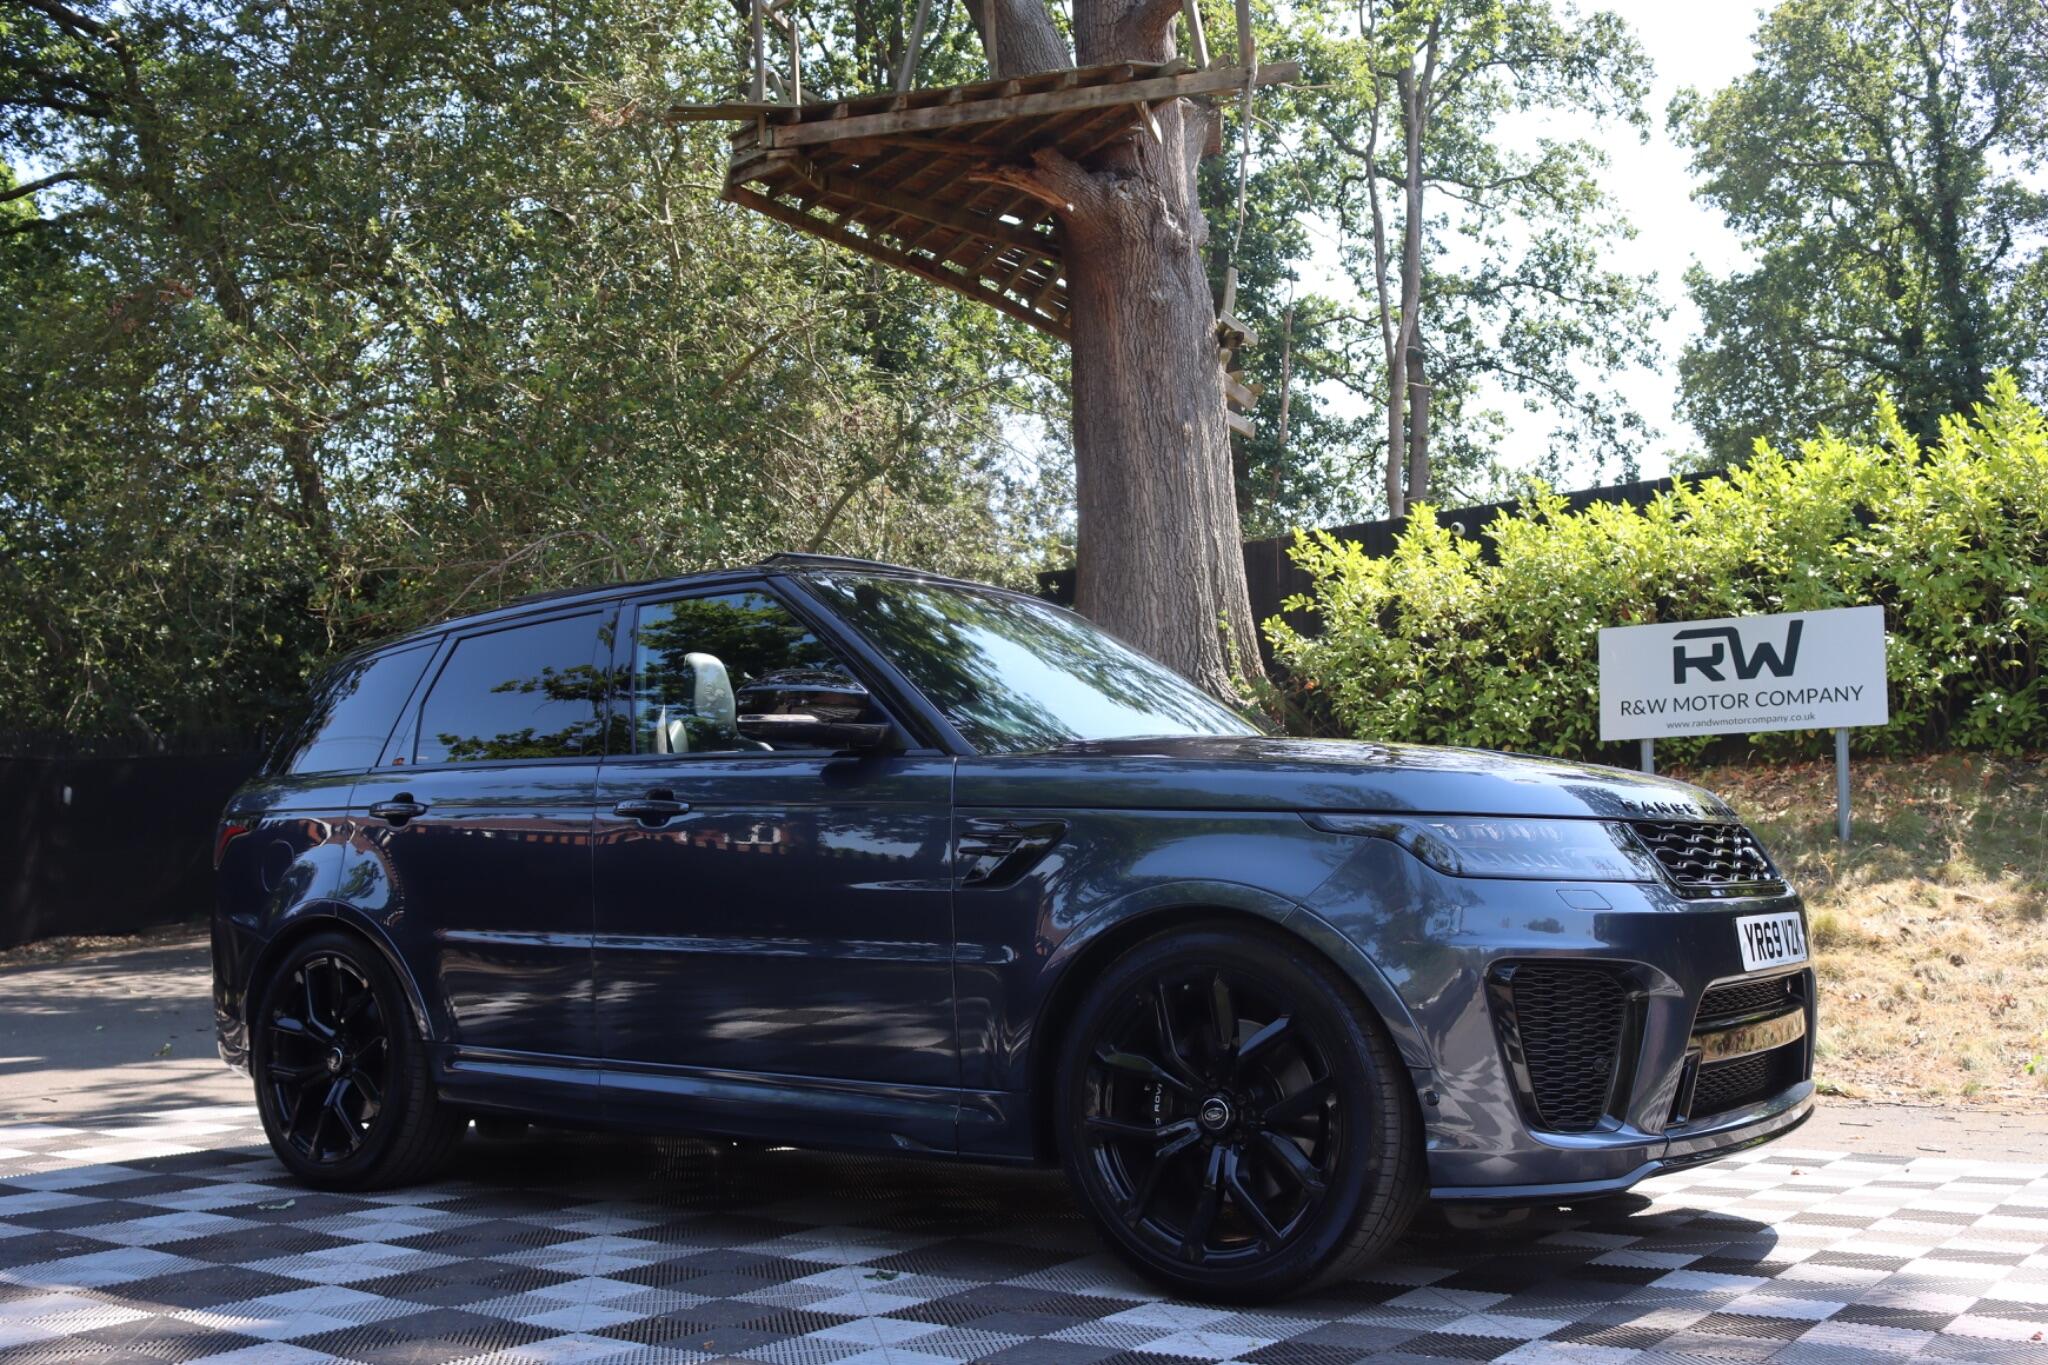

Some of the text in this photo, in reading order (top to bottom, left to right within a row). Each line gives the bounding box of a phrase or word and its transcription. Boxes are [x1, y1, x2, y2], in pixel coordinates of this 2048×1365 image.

[1673, 619, 1804, 684] RW
[1620, 684, 1864, 717] R&W MOTOR COMPANY
[1666, 711, 1816, 729] www.randwmotorcompany.co.uk
[1744, 919, 1803, 962] YR69 VZK
